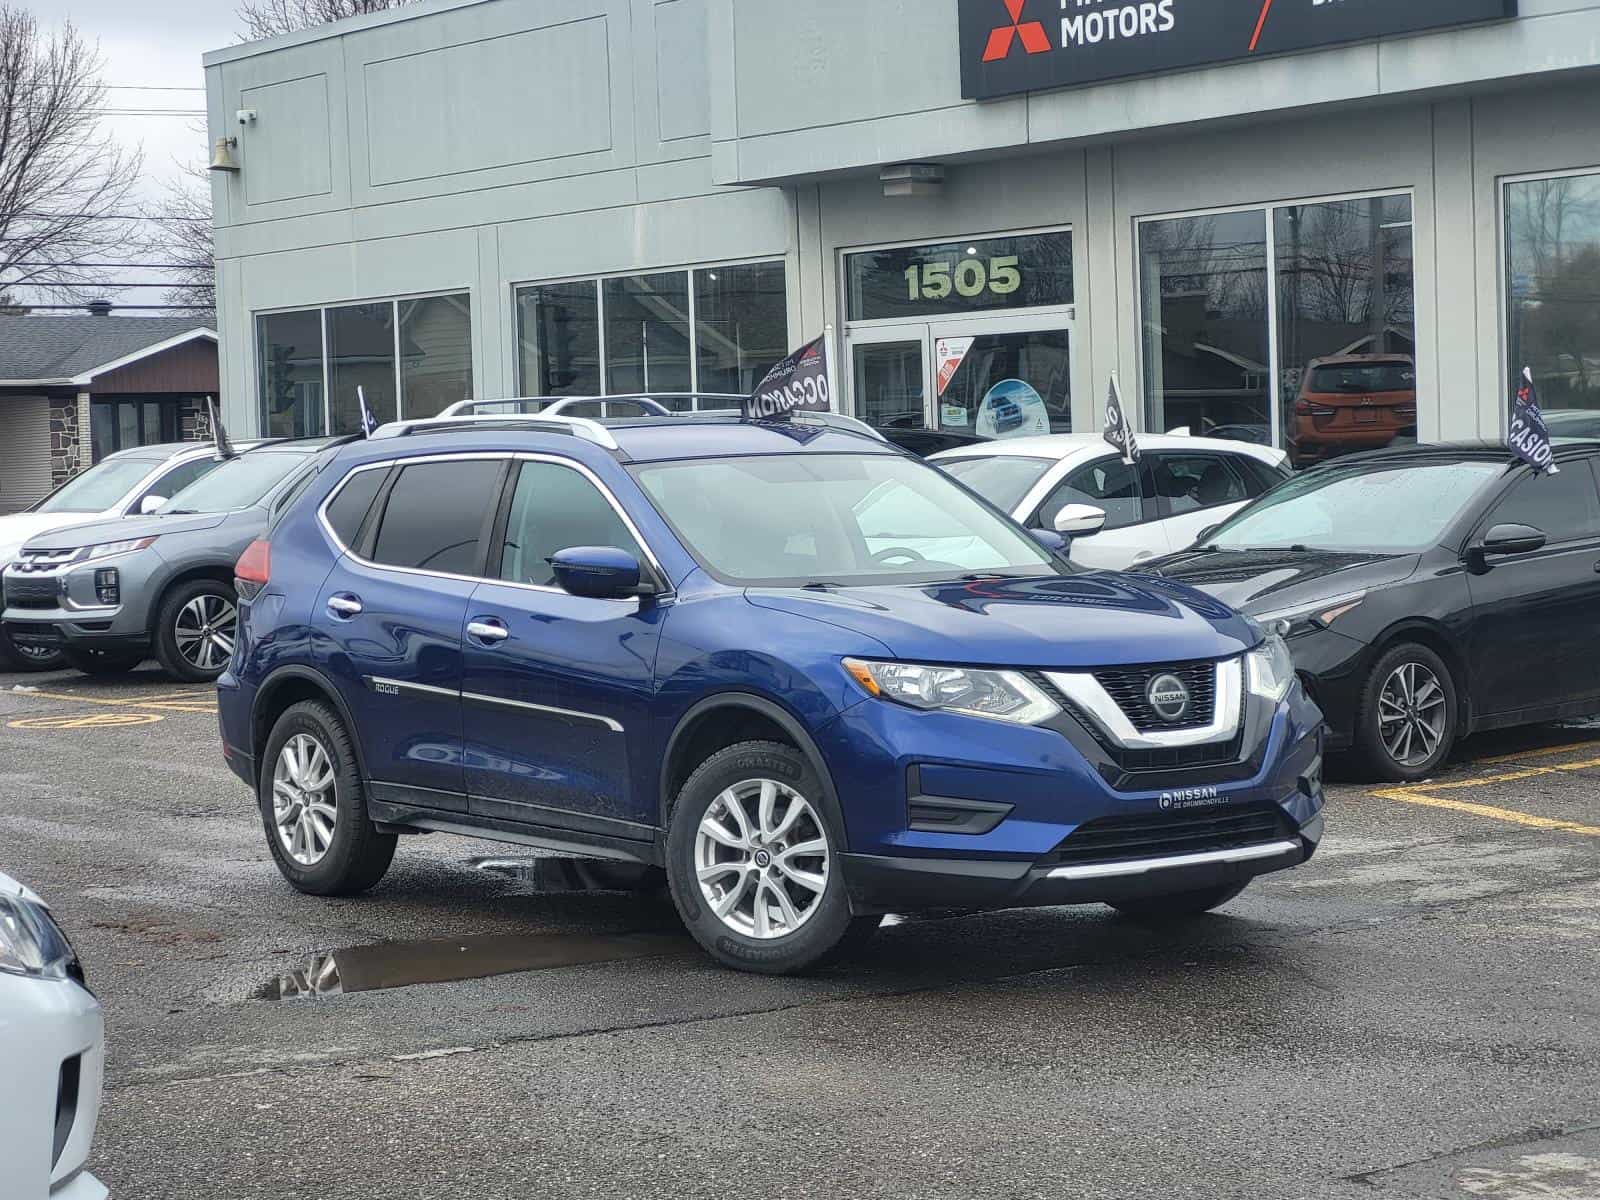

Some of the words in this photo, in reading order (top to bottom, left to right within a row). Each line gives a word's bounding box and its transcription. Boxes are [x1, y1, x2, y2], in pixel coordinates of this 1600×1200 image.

[1061, 0, 1175, 48] MOTORS
[904, 256, 1021, 300] 1505
[375, 683, 399, 695] ROGUE
[1154, 693, 1187, 702] NISSAN
[1173, 786, 1217, 801] NISSAN
